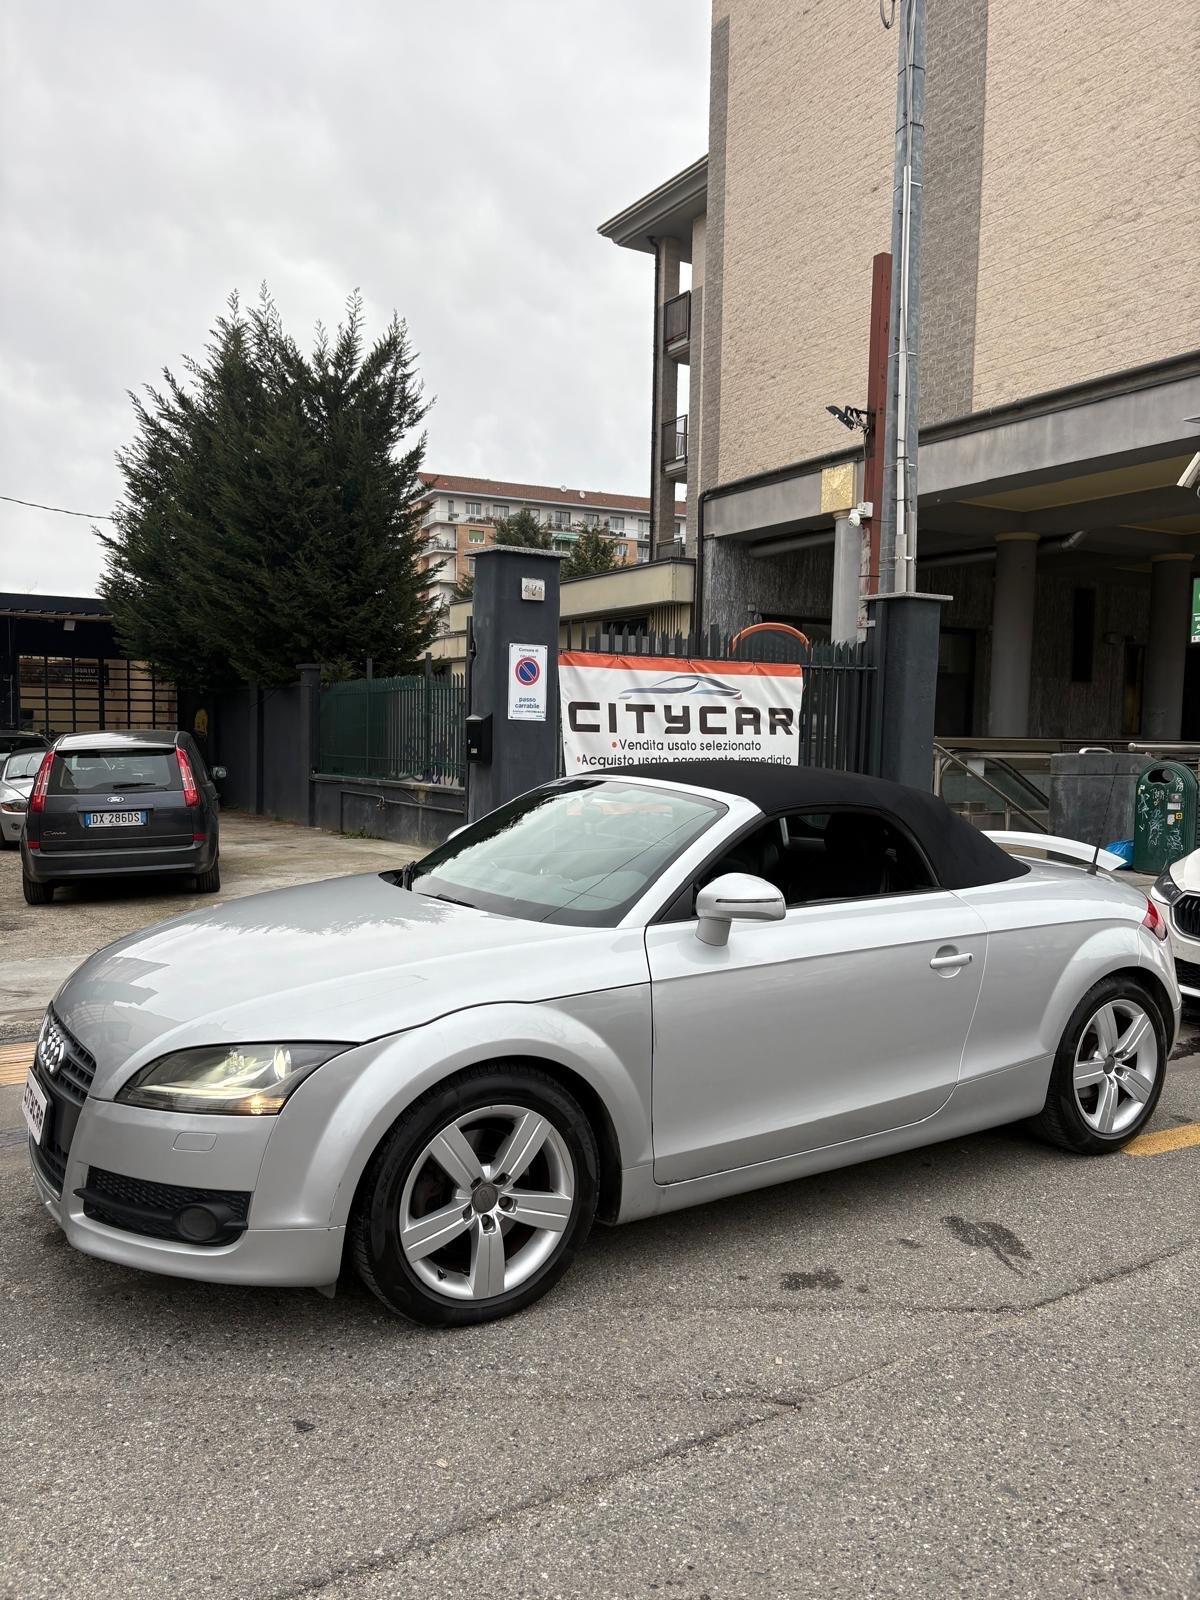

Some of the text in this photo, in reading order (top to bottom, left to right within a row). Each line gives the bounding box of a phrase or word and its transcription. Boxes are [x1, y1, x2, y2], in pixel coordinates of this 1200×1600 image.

[568, 701, 794, 735] CITYCAR
[618, 739, 762, 751] Vendita usato selezionato
[581, 754, 634, 768] Acquisto
[638, 754, 669, 764] usato
[92, 812, 140, 824] DX 286DS
